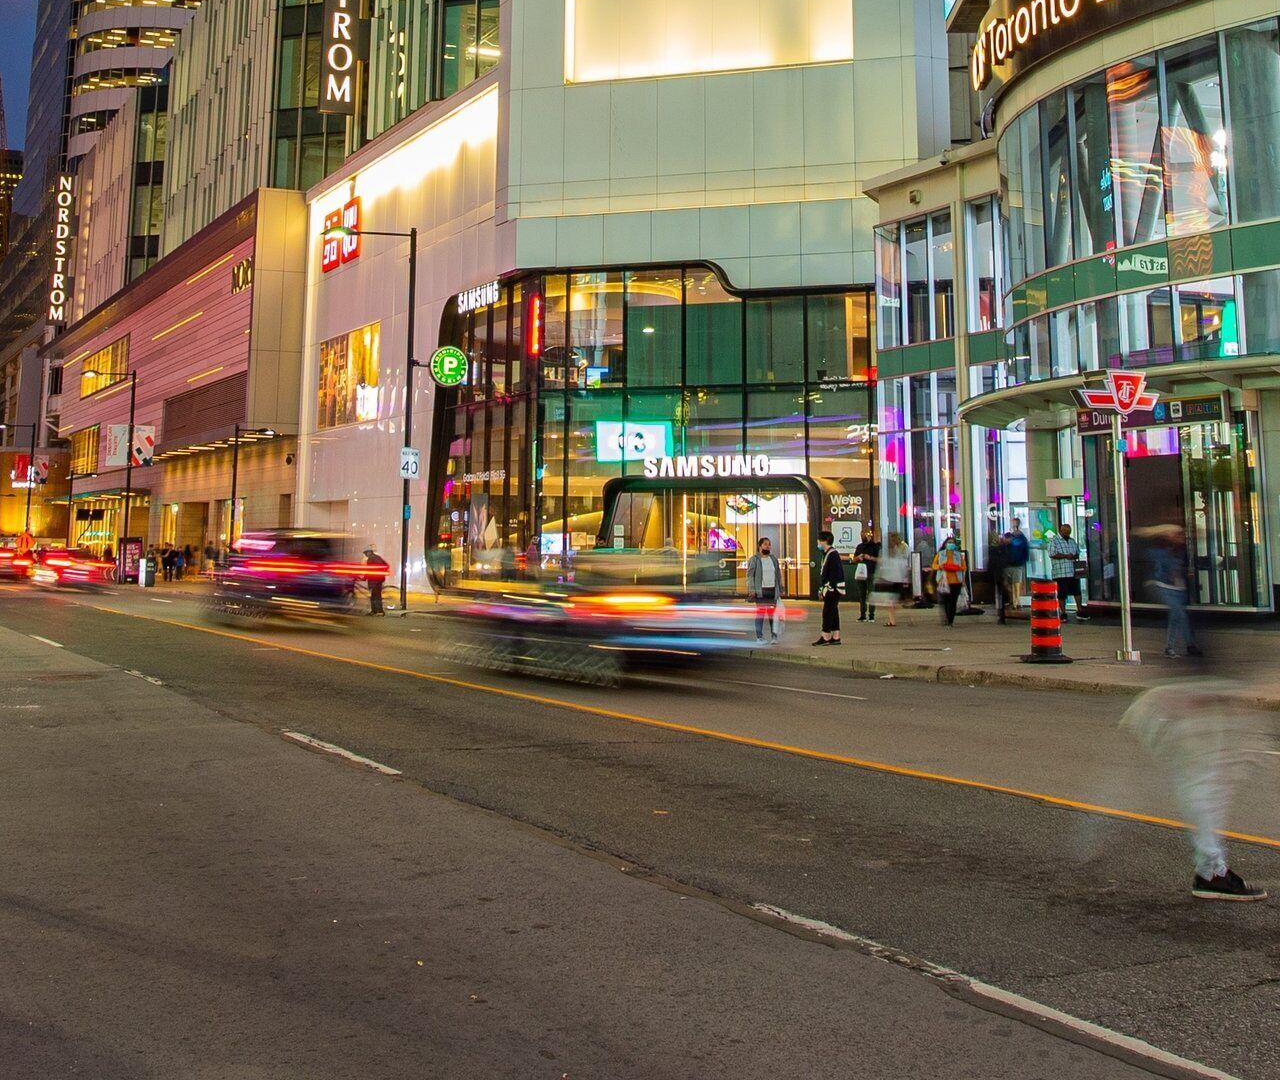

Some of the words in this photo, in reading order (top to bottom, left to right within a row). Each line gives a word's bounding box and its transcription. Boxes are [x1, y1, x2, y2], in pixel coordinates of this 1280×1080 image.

[48, 175, 74, 322] NORDSTROM
[458, 280, 500, 314] SAMSUNG
[1092, 410, 1128, 426] Duns
[401, 461, 418, 474] 40
[643, 454, 770, 478] SAMSUNG
[830, 494, 863, 506] We're
[830, 505, 862, 518] open
